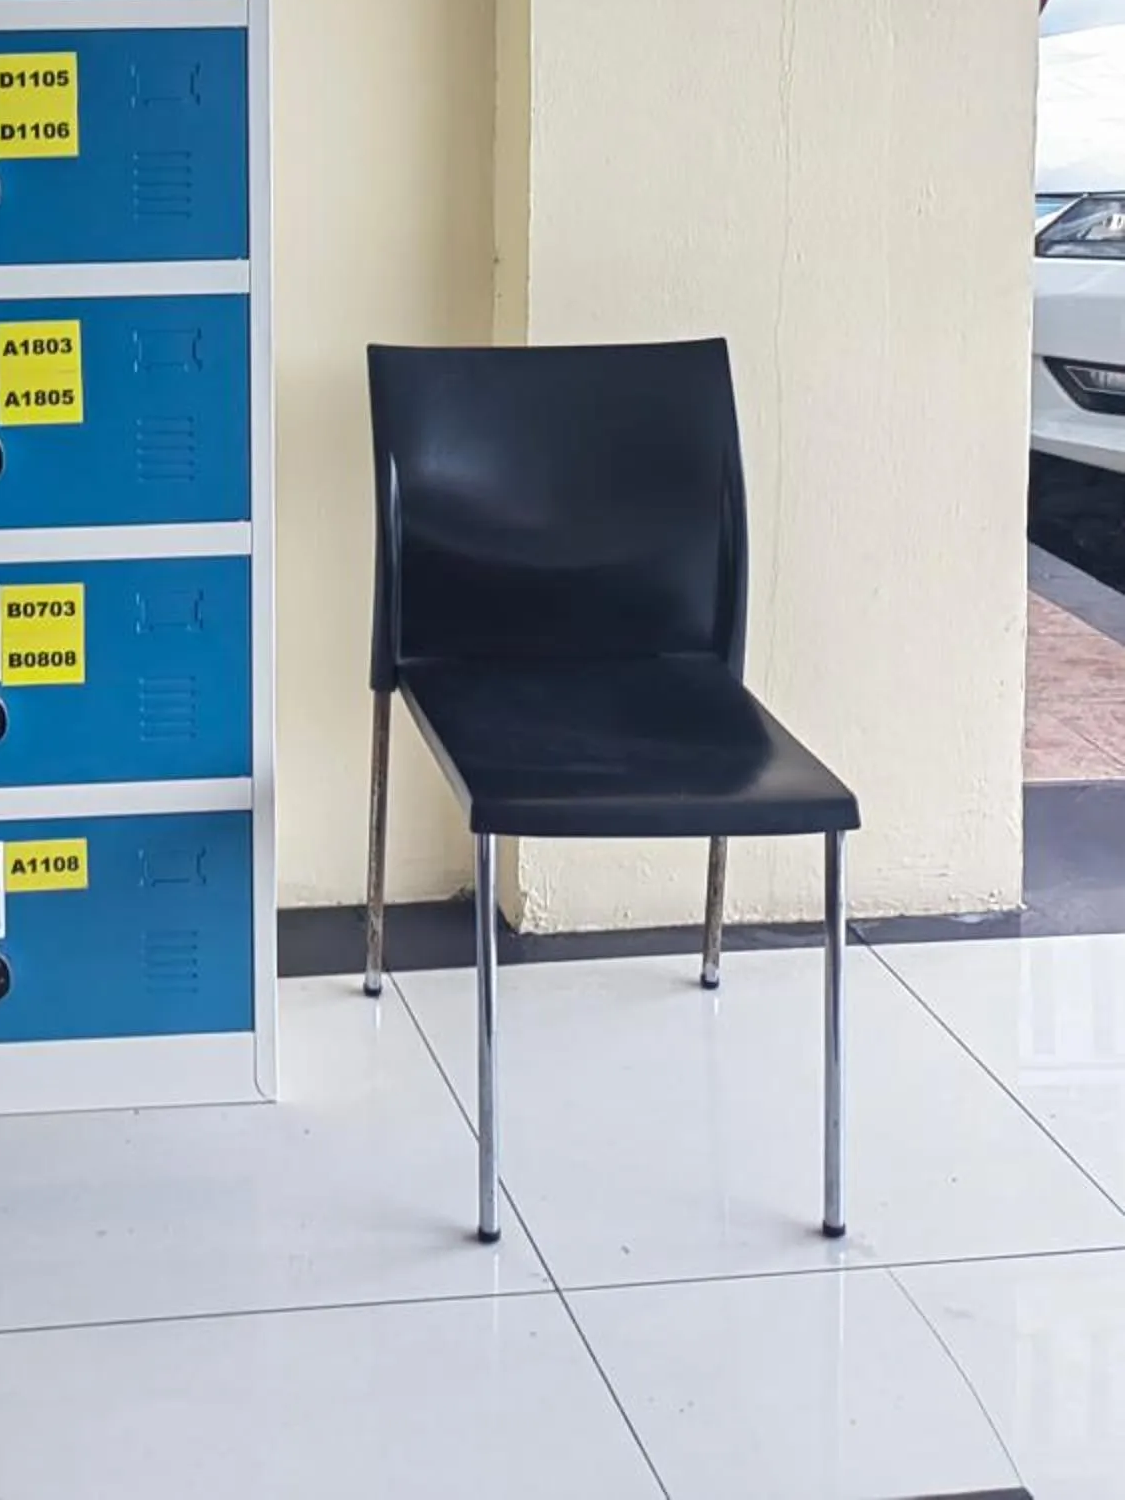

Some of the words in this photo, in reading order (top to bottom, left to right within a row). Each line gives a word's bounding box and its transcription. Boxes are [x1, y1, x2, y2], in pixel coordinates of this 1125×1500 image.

[0, 122, 70, 141] D1106
[1, 337, 73, 357] A1803
[4, 389, 75, 408] A1805
[6, 601, 76, 619] B0703
[8, 650, 77, 668] B0808
[10, 855, 80, 875] A1108
